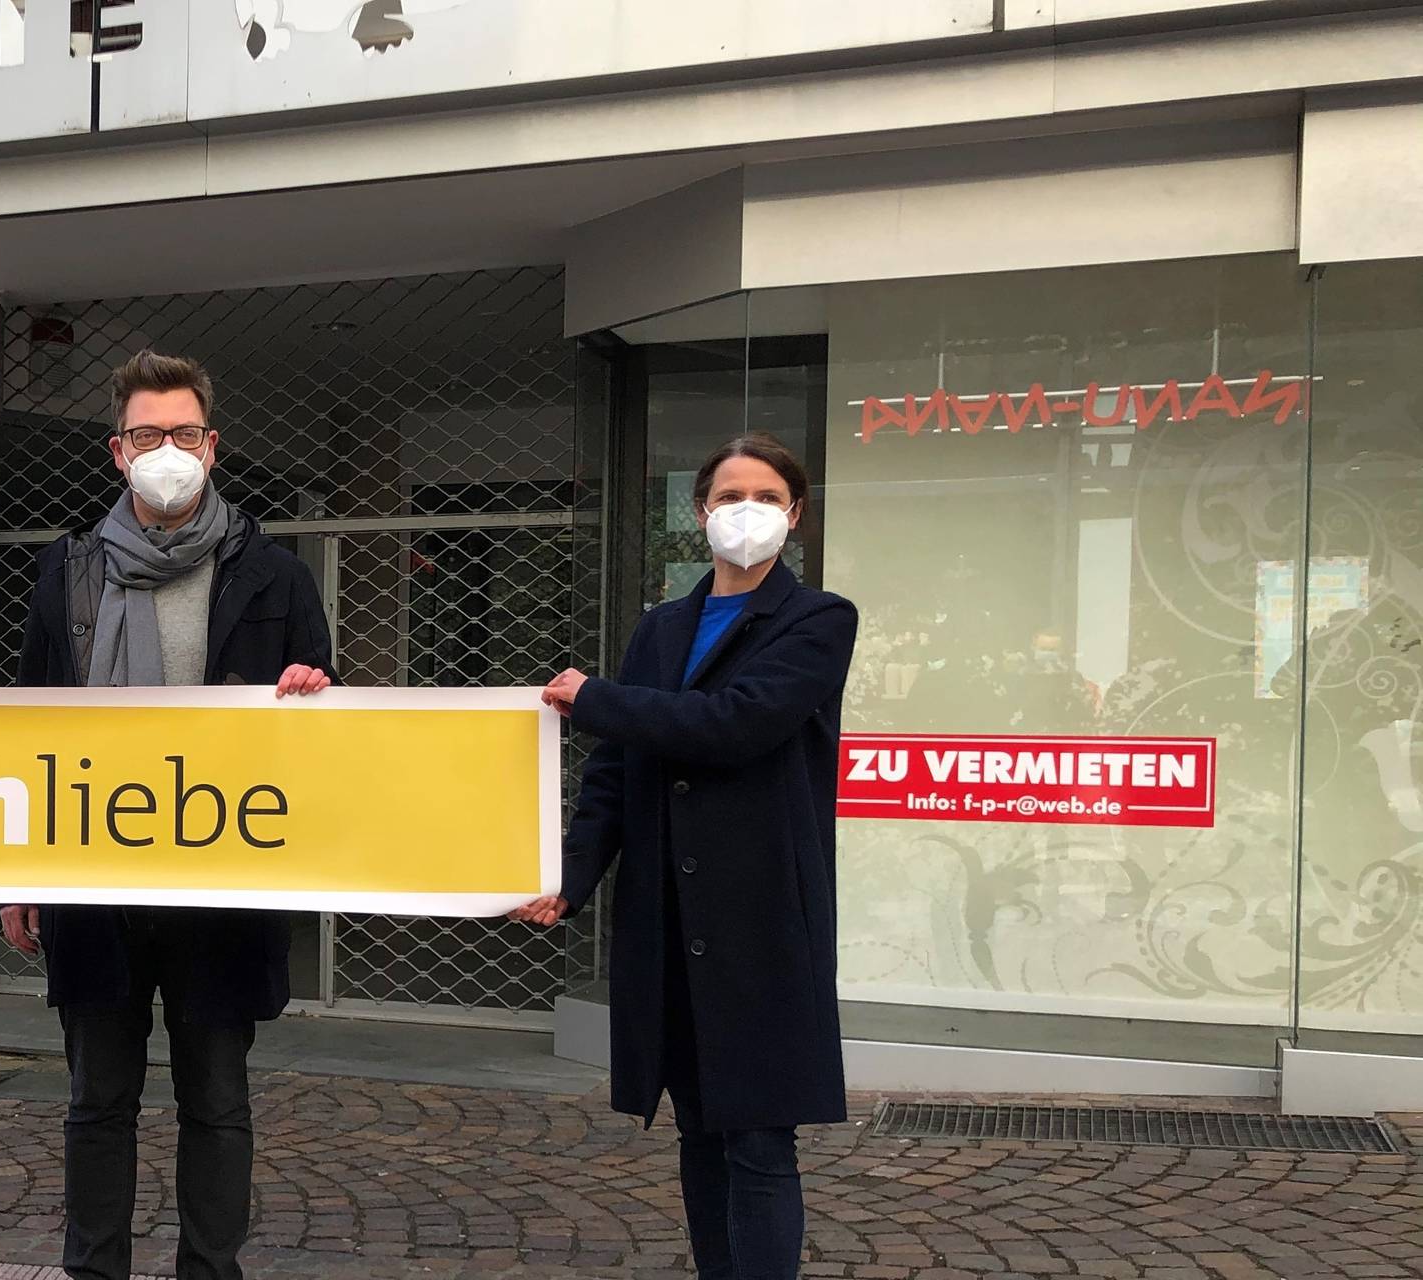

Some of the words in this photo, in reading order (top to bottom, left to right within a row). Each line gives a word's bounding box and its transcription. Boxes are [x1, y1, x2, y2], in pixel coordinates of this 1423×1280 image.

[846, 750, 908, 781] ZU
[923, 750, 1196, 788] VERMIETEN
[907, 793, 956, 811] Info:
[964, 794, 1122, 816] f-p-r@web.de
